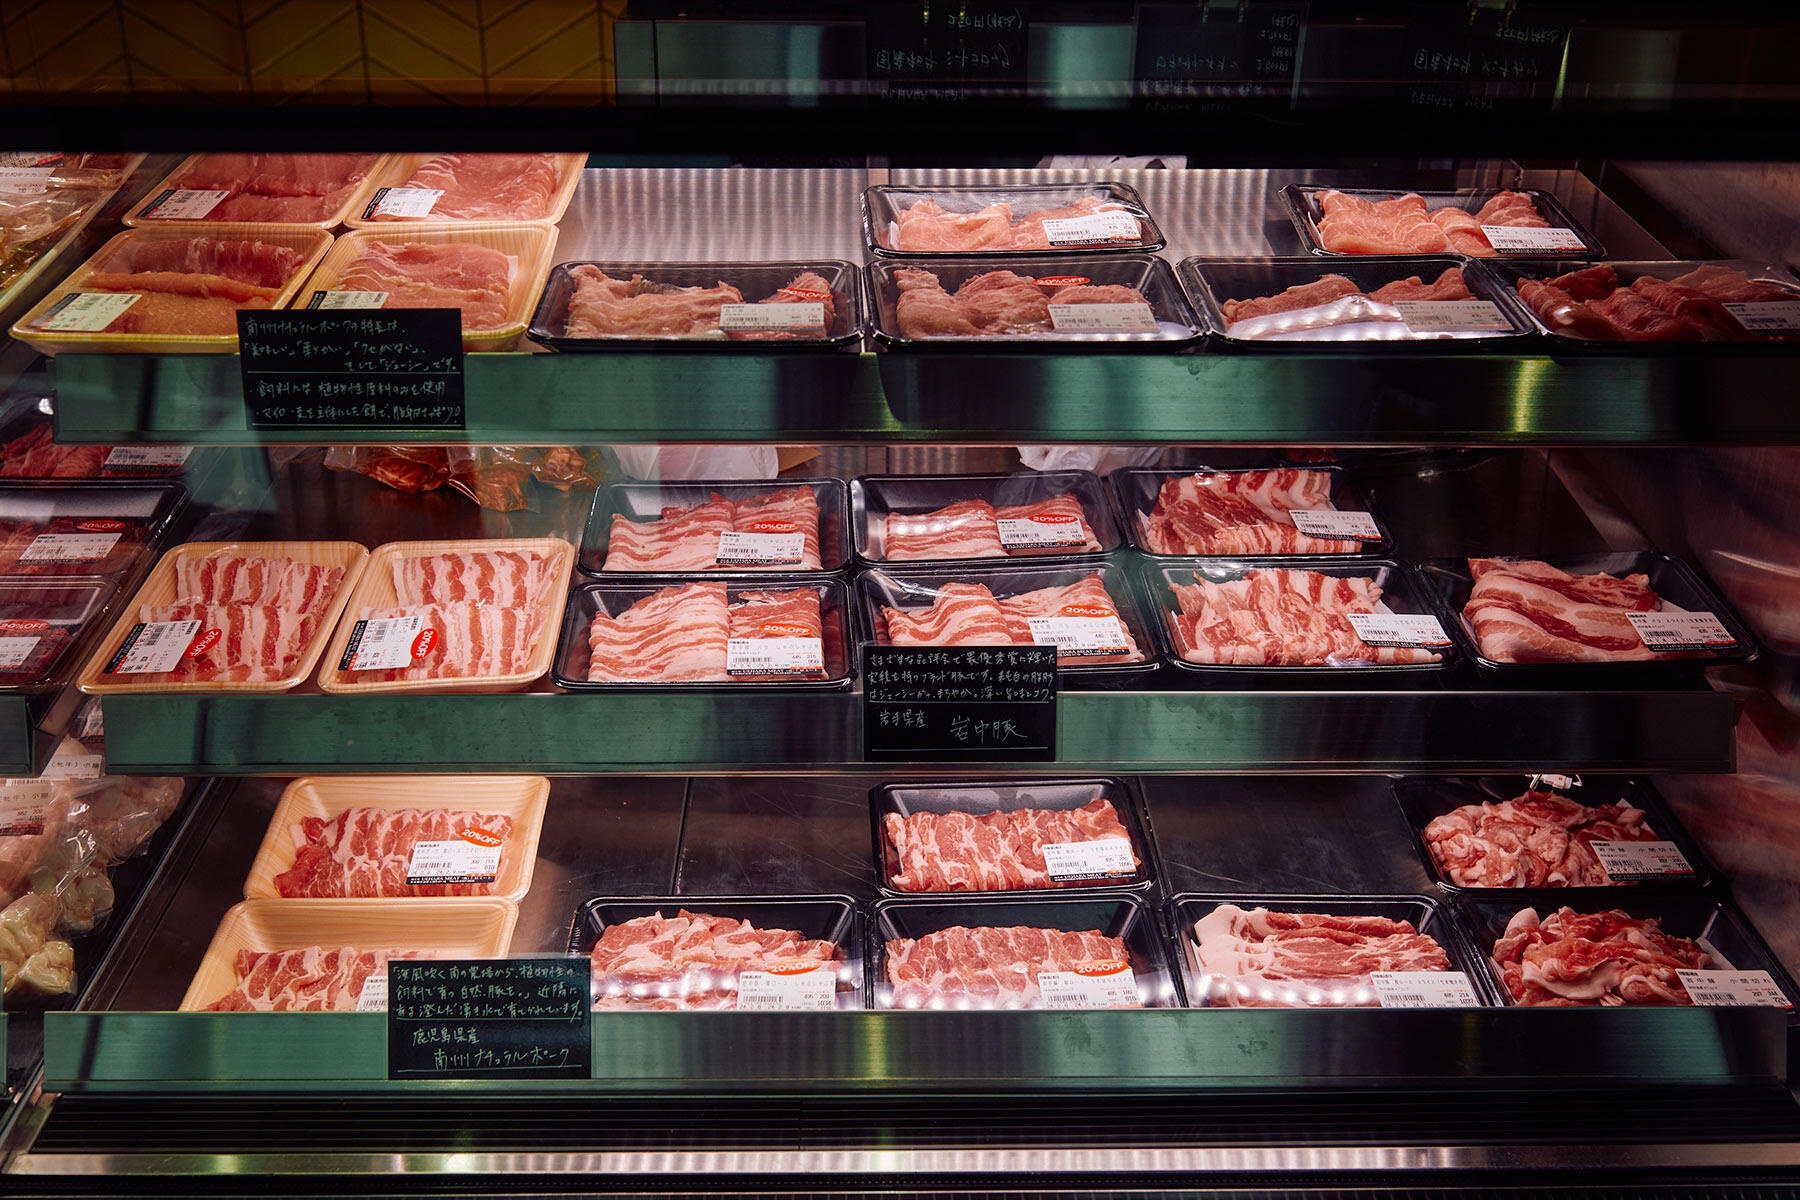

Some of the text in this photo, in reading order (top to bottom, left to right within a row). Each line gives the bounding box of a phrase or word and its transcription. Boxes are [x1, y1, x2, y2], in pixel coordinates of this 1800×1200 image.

[1037, 276, 1085, 285] 20%OFF
[1065, 607, 1112, 616] 20%OFF
[763, 625, 810, 634] 20%OFF
[189, 630, 219, 657] 20%OFF
[415, 630, 434, 658] 20%OFF
[880, 708, 926, 728] 岩手県産
[950, 714, 1028, 744] 岩中豚
[461, 829, 500, 845] 20%OFF
[771, 960, 817, 973] 20%OFF
[1077, 962, 1124, 974] 20%OFF
[412, 1026, 480, 1047] 鹿児島県産
